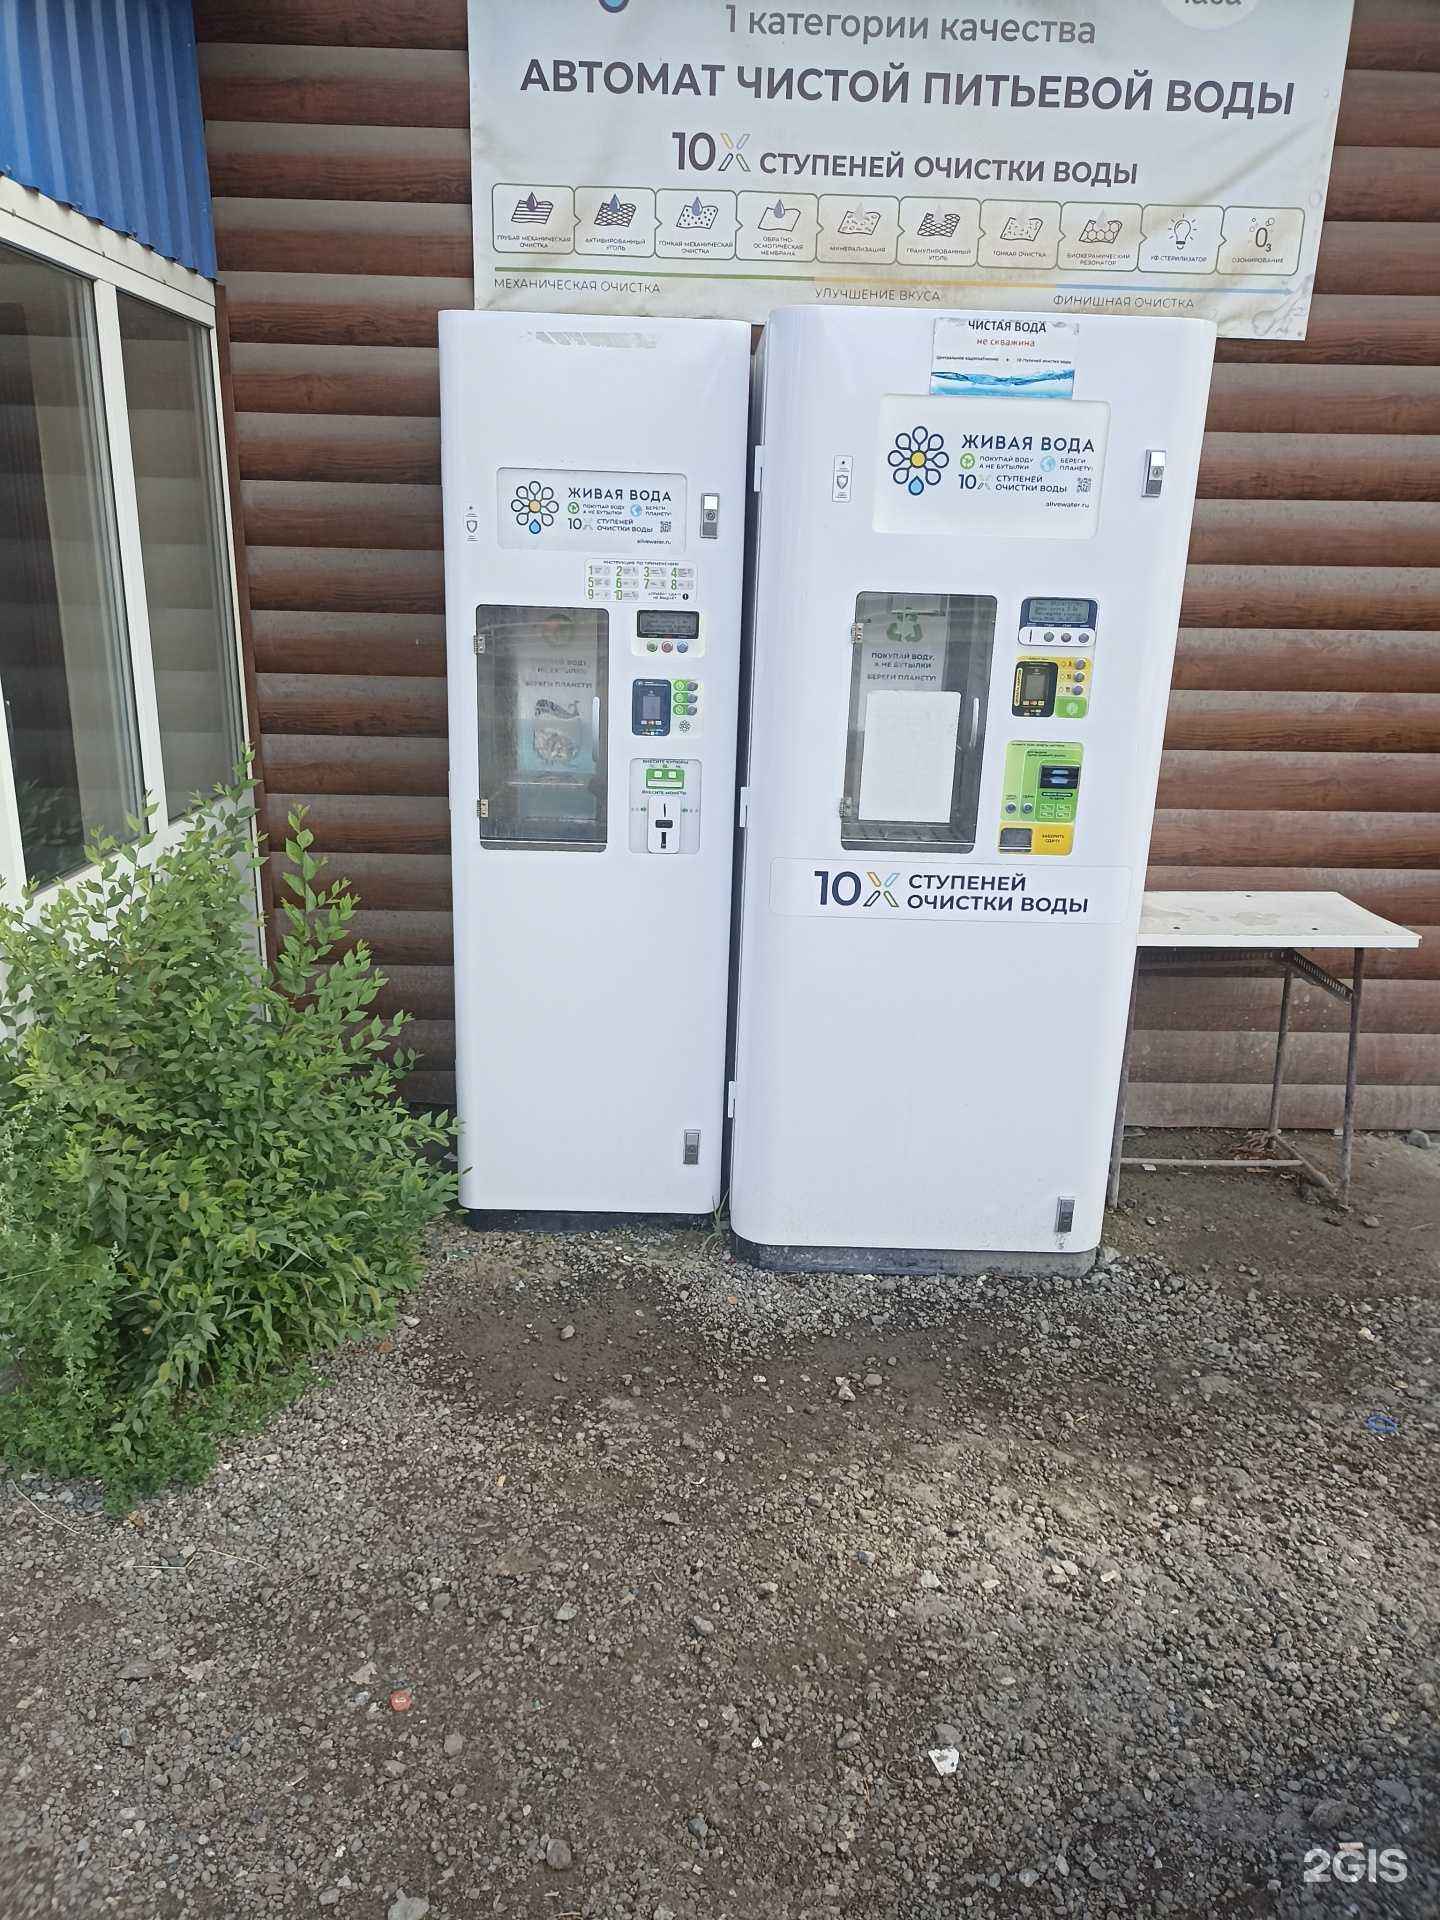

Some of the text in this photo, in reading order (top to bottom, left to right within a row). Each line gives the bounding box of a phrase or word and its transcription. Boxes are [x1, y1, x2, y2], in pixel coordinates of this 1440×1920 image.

[726, 4, 1097, 45] 1 категории качества
[520, 58, 1295, 119] АВТОМАТ ЧИСТОЙ ПИТЬЕВОЙ ВОДЫ
[759, 150, 904, 179] СТУПЕНЕЙ
[914, 156, 1045, 183] ОЧИСТКИ
[1053, 160, 1138, 187] ВОДЫ
[584, 237, 646, 245] АКТИВИРОВАННЫЙ
[683, 241, 734, 249] МЕХАНИЧЕСКАЯ
[829, 245, 887, 253] МИНЕРАЛИЗАЦИЯ
[906, 247, 972, 255] ГРАНУЛИРОВАННЫЙ
[1079, 259, 1117, 267] РЕЗОНАТОР
[494, 278, 661, 294] МЕХАНИЧЕСКАЯ ОЧИСТКА
[815, 287, 941, 302] УЛУЧШЕНИЕ ВКУСА
[1053, 295, 1195, 309] ФИНИШНАЯ ОЧИСТКА
[968, 319, 1047, 334] ЧИСТАЯ ВОДА
[976, 338, 1036, 348] не скважина
[961, 434, 1095, 454] ЖИВАЯ ВОДА
[979, 455, 1013, 463] ПОКУПАЙ
[996, 474, 1043, 483] СТУПЕНЕЙ
[995, 483, 1067, 494] ОЧИСТКИ ВОДЫ
[568, 487, 672, 503] ЖИВАЯ ВОДА
[596, 518, 634, 526] СТУПЕНЕЙ
[596, 525, 653, 534] ОЧИСТКИ ВОДЫ
[588, 565, 593, 575] 1
[616, 565, 623, 577] 2
[643, 566, 650, 578] 3
[671, 567, 678, 578] 4
[588, 577, 594, 588] 5
[615, 578, 622, 589] 6
[643, 579, 650, 590] 7
[670, 579, 677, 591] 8
[587, 588, 594, 600] 9
[614, 589, 623, 601] 10
[871, 651, 910, 660] ПОКУПАЙ
[867, 673, 896, 681] БЕРЕГИ
[908, 873, 1027, 892] СТУПЕНЕЙ
[907, 894, 1089, 916] ОЧИСТКИ ВОДЫ
